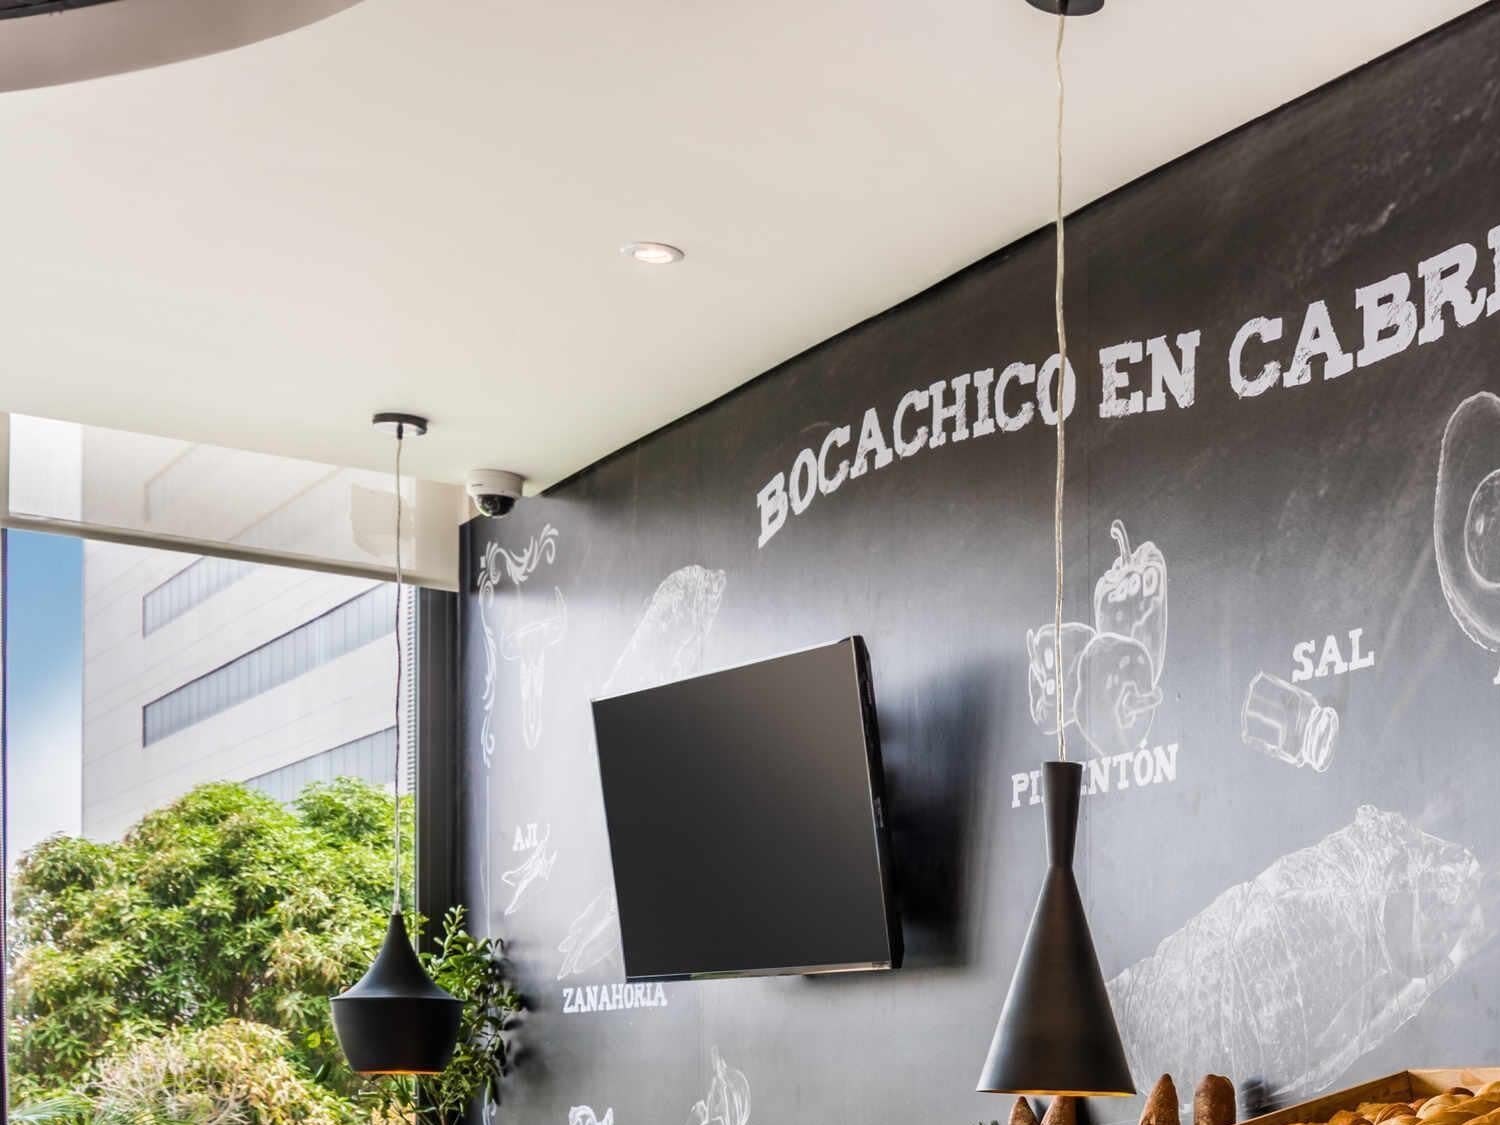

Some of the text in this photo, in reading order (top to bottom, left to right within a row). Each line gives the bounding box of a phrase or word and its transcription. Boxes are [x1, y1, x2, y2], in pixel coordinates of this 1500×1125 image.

[756, 352, 1077, 548] BOCACHICO
[1098, 329, 1199, 420] EN
[1291, 627, 1376, 683] SAL
[562, 982, 668, 1014] ZANAHORIA
